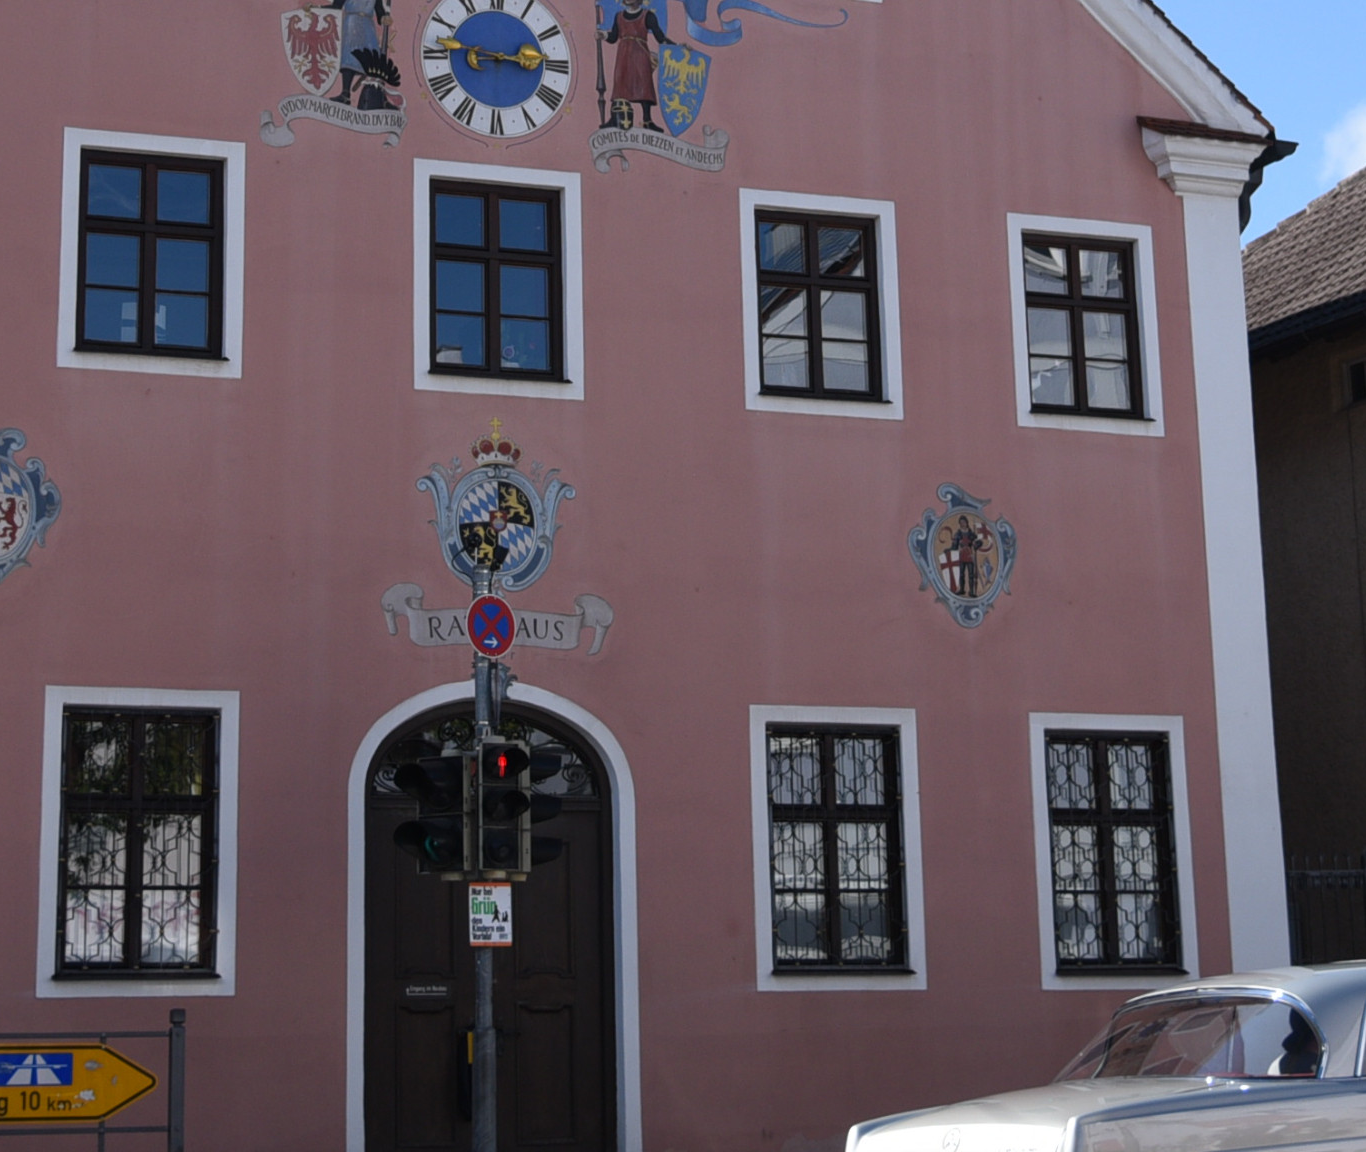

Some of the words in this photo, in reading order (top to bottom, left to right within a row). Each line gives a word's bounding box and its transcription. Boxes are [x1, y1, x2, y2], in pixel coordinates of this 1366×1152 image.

[592, 131, 629, 149] COMITES
[642, 133, 674, 153] DIEZZEN
[685, 149, 723, 165] ANDECHS
[428, 615, 564, 641] RAAUS
[472, 897, 496, 915] Grün
[20, 1092, 41, 1112] 10
[47, 1096, 72, 1112] km
